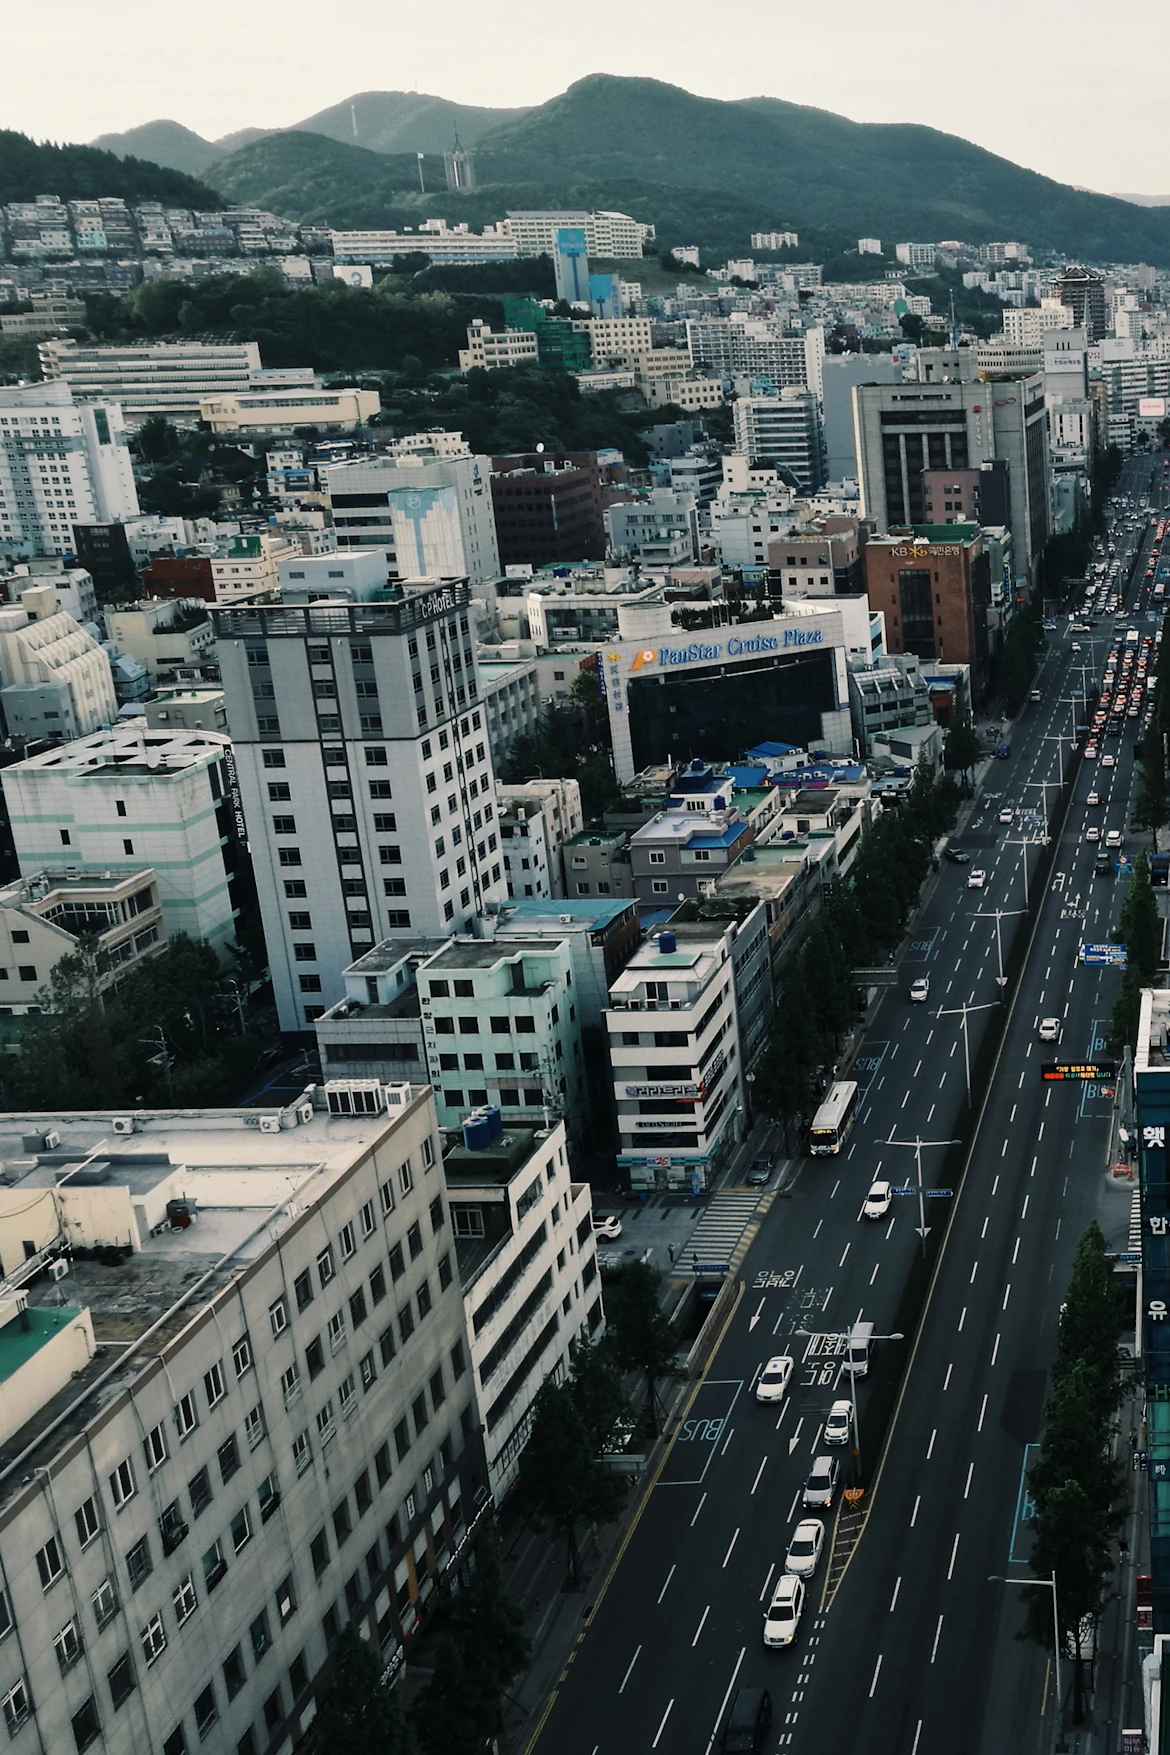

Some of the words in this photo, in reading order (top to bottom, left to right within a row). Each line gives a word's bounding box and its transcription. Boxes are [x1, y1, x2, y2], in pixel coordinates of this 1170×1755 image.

[892, 547, 908, 557] KB
[432, 592, 455, 614] HOTEL
[660, 642, 723, 666] PanStar
[728, 633, 779, 655] Cruise
[784, 628, 823, 647] Plaza
[224, 749, 237, 786] CENTRAL
[231, 787, 241, 808] PARK
[235, 811, 246, 838] HOTEL
[911, 940, 934, 951] BUS
[855, 1057, 881, 1071] BUS
[647, 1157, 669, 1165] GS25
[678, 1418, 724, 1441] BUS
